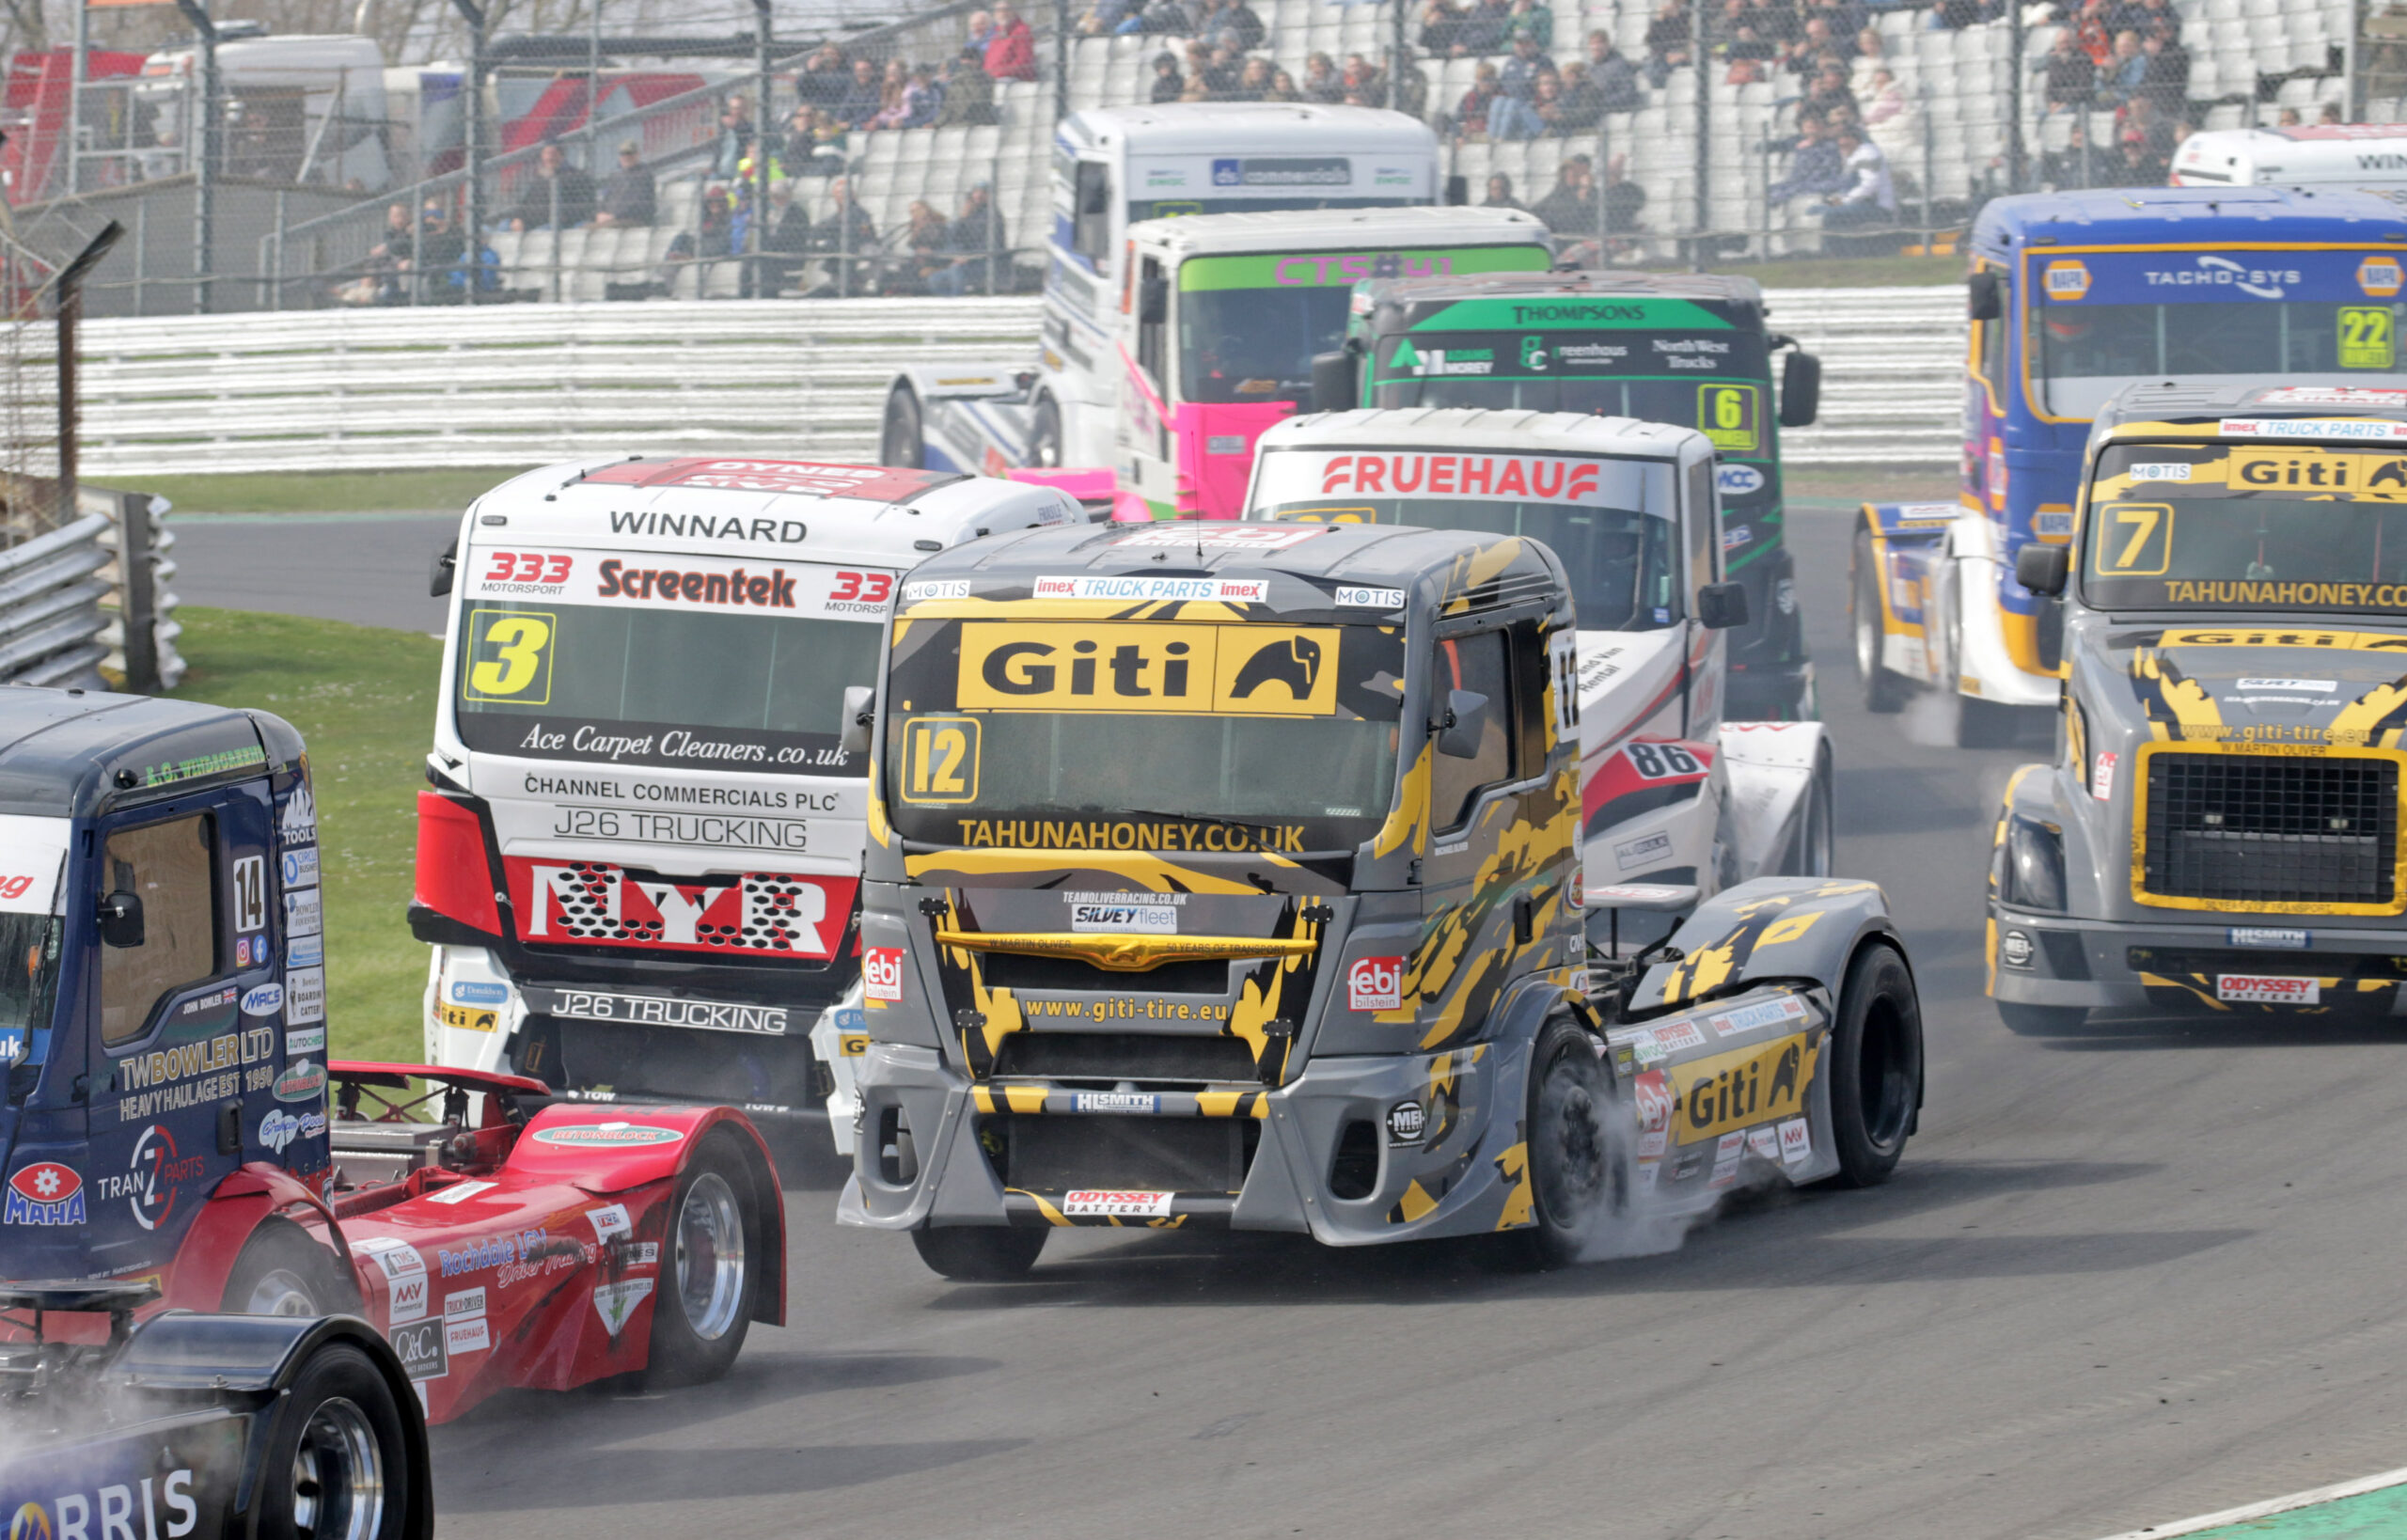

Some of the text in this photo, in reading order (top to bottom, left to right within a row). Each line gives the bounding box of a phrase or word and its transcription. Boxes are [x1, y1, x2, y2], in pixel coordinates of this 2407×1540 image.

[1512, 305, 1646, 324] THOMPSONS
[2343, 311, 2386, 347] 22
[1715, 389, 1742, 429] 6
[2266, 420, 2321, 435] TRUCK
[2329, 423, 2386, 437] PARTS
[1322, 455, 1600, 500] FRUEHAUF
[2242, 461, 2349, 486] Giti
[609, 511, 809, 543] WINNARD
[2116, 511, 2160, 568] 7
[481, 582, 564, 596] MOTORSPORT
[485, 552, 574, 584] 333
[598, 559, 796, 608] Screentek
[908, 582, 969, 598] MOTIS
[1037, 578, 1263, 600] imex TRUCK PARTS imex
[1337, 588, 1403, 605] MOTIS
[471, 617, 549, 695] 3
[2179, 634, 2335, 646] Giti
[982, 639, 1190, 697] Giti
[520, 723, 565, 750] Ace
[573, 726, 653, 760] Carpet
[2180, 724, 2370, 743] www.giti-tire.eu
[913, 729, 967, 793] 12
[1627, 743, 1699, 778] 86
[525, 777, 837, 811] CHANNEL COMMERCIALS PLC
[283, 827, 316, 844] TOOLS
[554, 809, 807, 848] J26 TRUCKING
[958, 819, 1305, 853] TAHUNAHONEY.CO.UK
[236, 859, 261, 928] 14
[1062, 891, 1188, 905] TEAMOLIVERRACING.CO.UK
[1075, 906, 1175, 925] SILVEY fleet
[999, 939, 1035, 948] MARTIN
[864, 948, 902, 993] febi
[1347, 959, 1401, 999] febi
[2221, 978, 2311, 993] ODYSSEY
[244, 990, 280, 1011] MACS
[552, 994, 787, 1032] J26 TRUCKING
[1026, 998, 1228, 1023] www.giti-tire.eu
[1355, 997, 1395, 1008] bilstein
[2221, 993, 2305, 1001] BATTERY
[240, 1027, 275, 1064] LTD
[119, 1065, 274, 1122] HEAVY HAULAGE EST 1950
[584, 1092, 615, 1102] TOW
[1690, 1061, 1757, 1129] Giti
[552, 1130, 659, 1142] BETONBLOCK
[4, 1186, 87, 1225] MAHA
[1067, 1204, 1156, 1213] BATTERY
[1068, 1192, 1166, 1203] ODYSSEY
[438, 1235, 515, 1278] Rochdale
